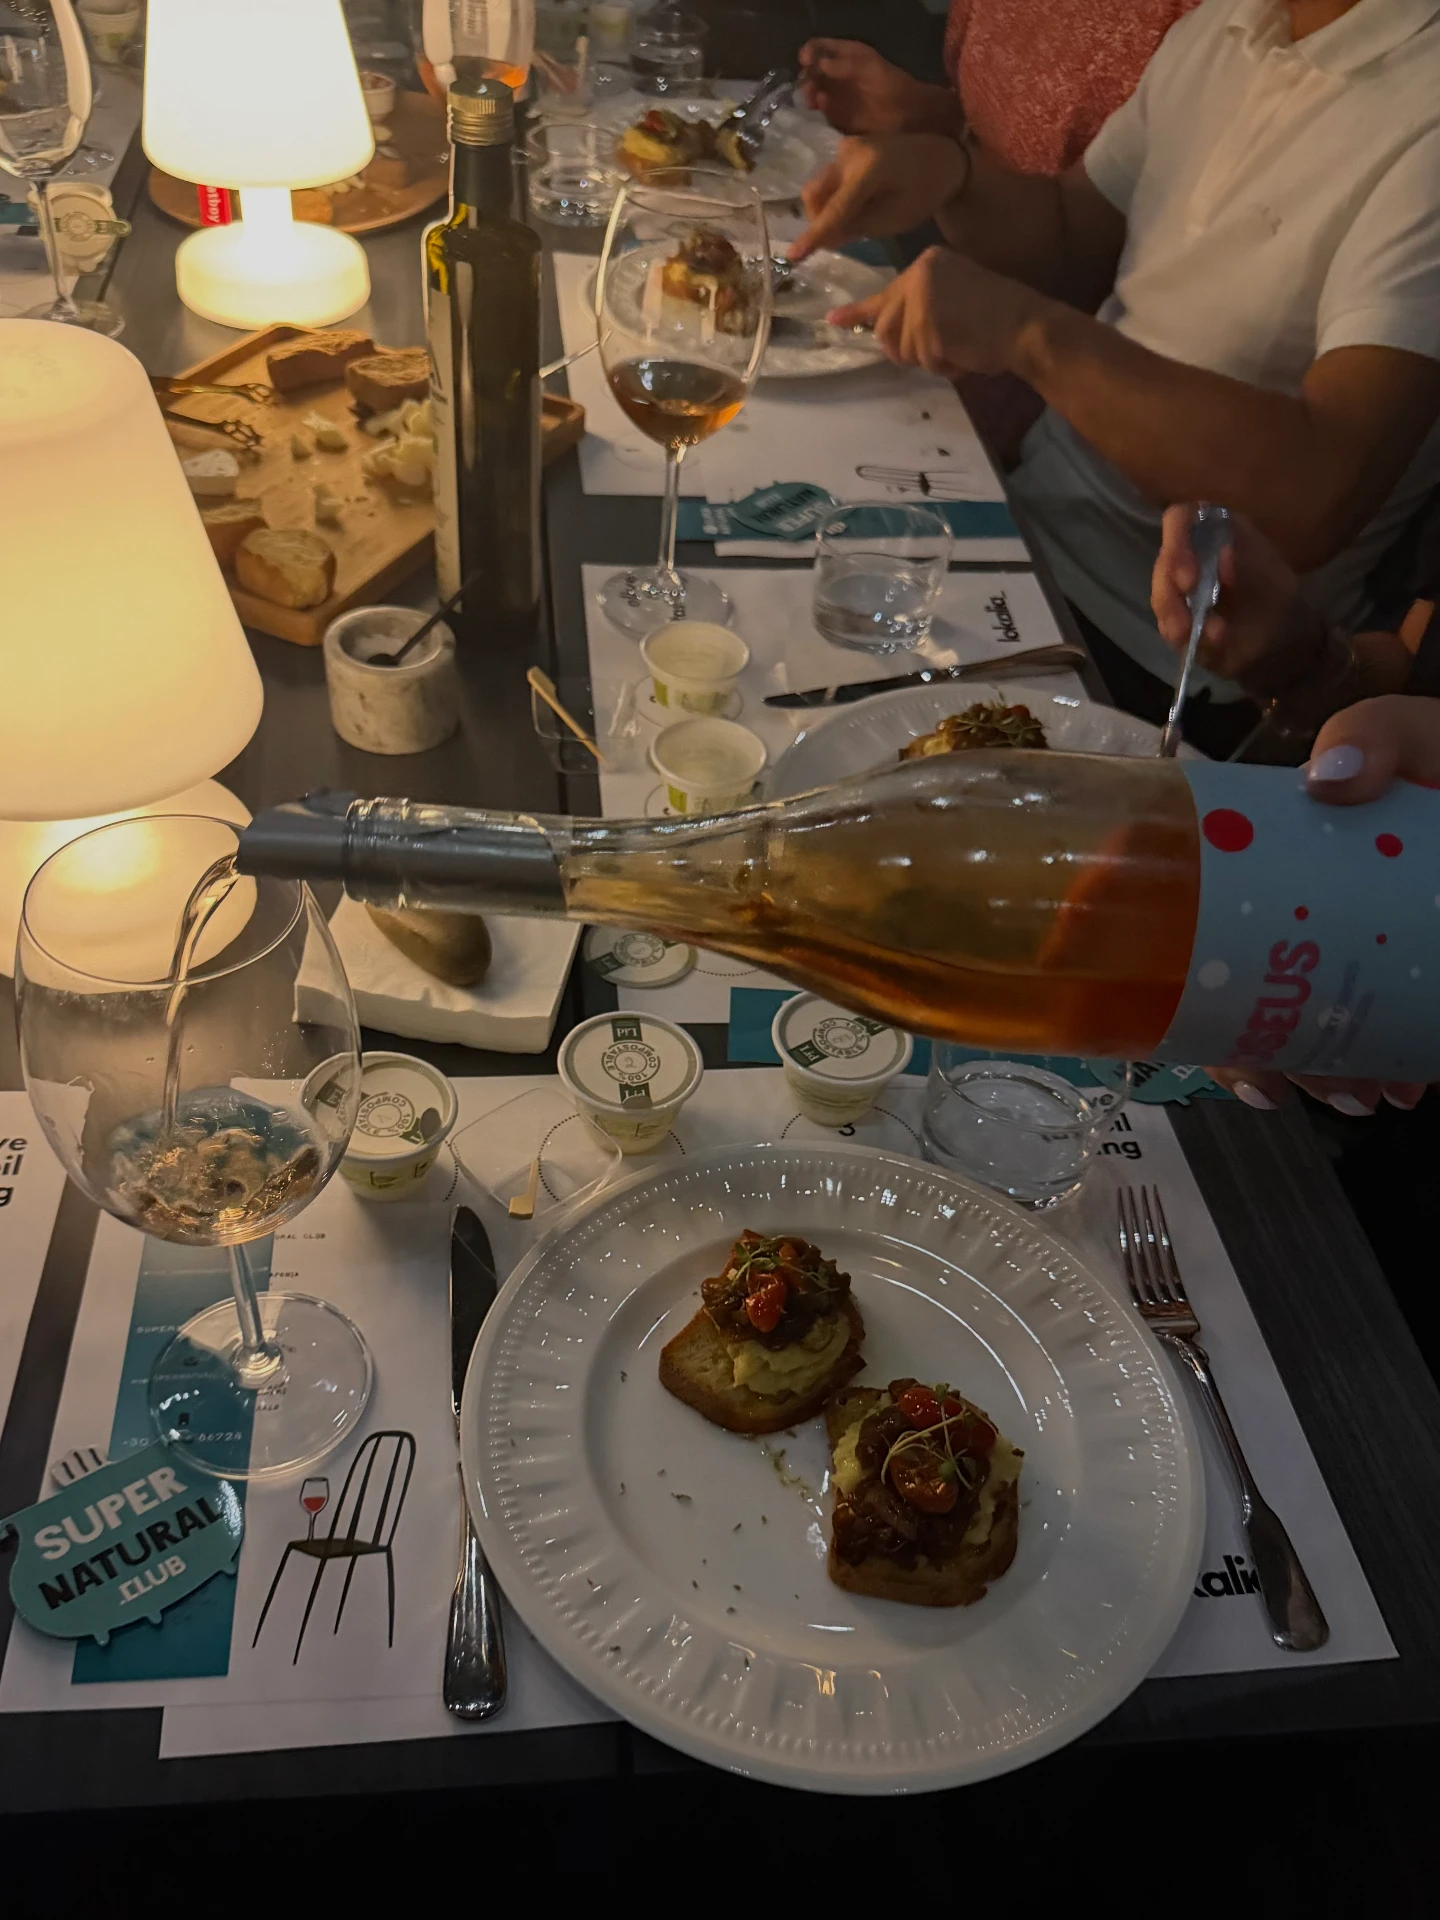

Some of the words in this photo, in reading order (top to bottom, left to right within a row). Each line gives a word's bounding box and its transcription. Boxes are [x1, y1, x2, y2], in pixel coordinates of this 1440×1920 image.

[34, 1466, 188, 1561] SUPER
[38, 1496, 224, 1611] NATURAL
[117, 1554, 187, 1606] CLUB
